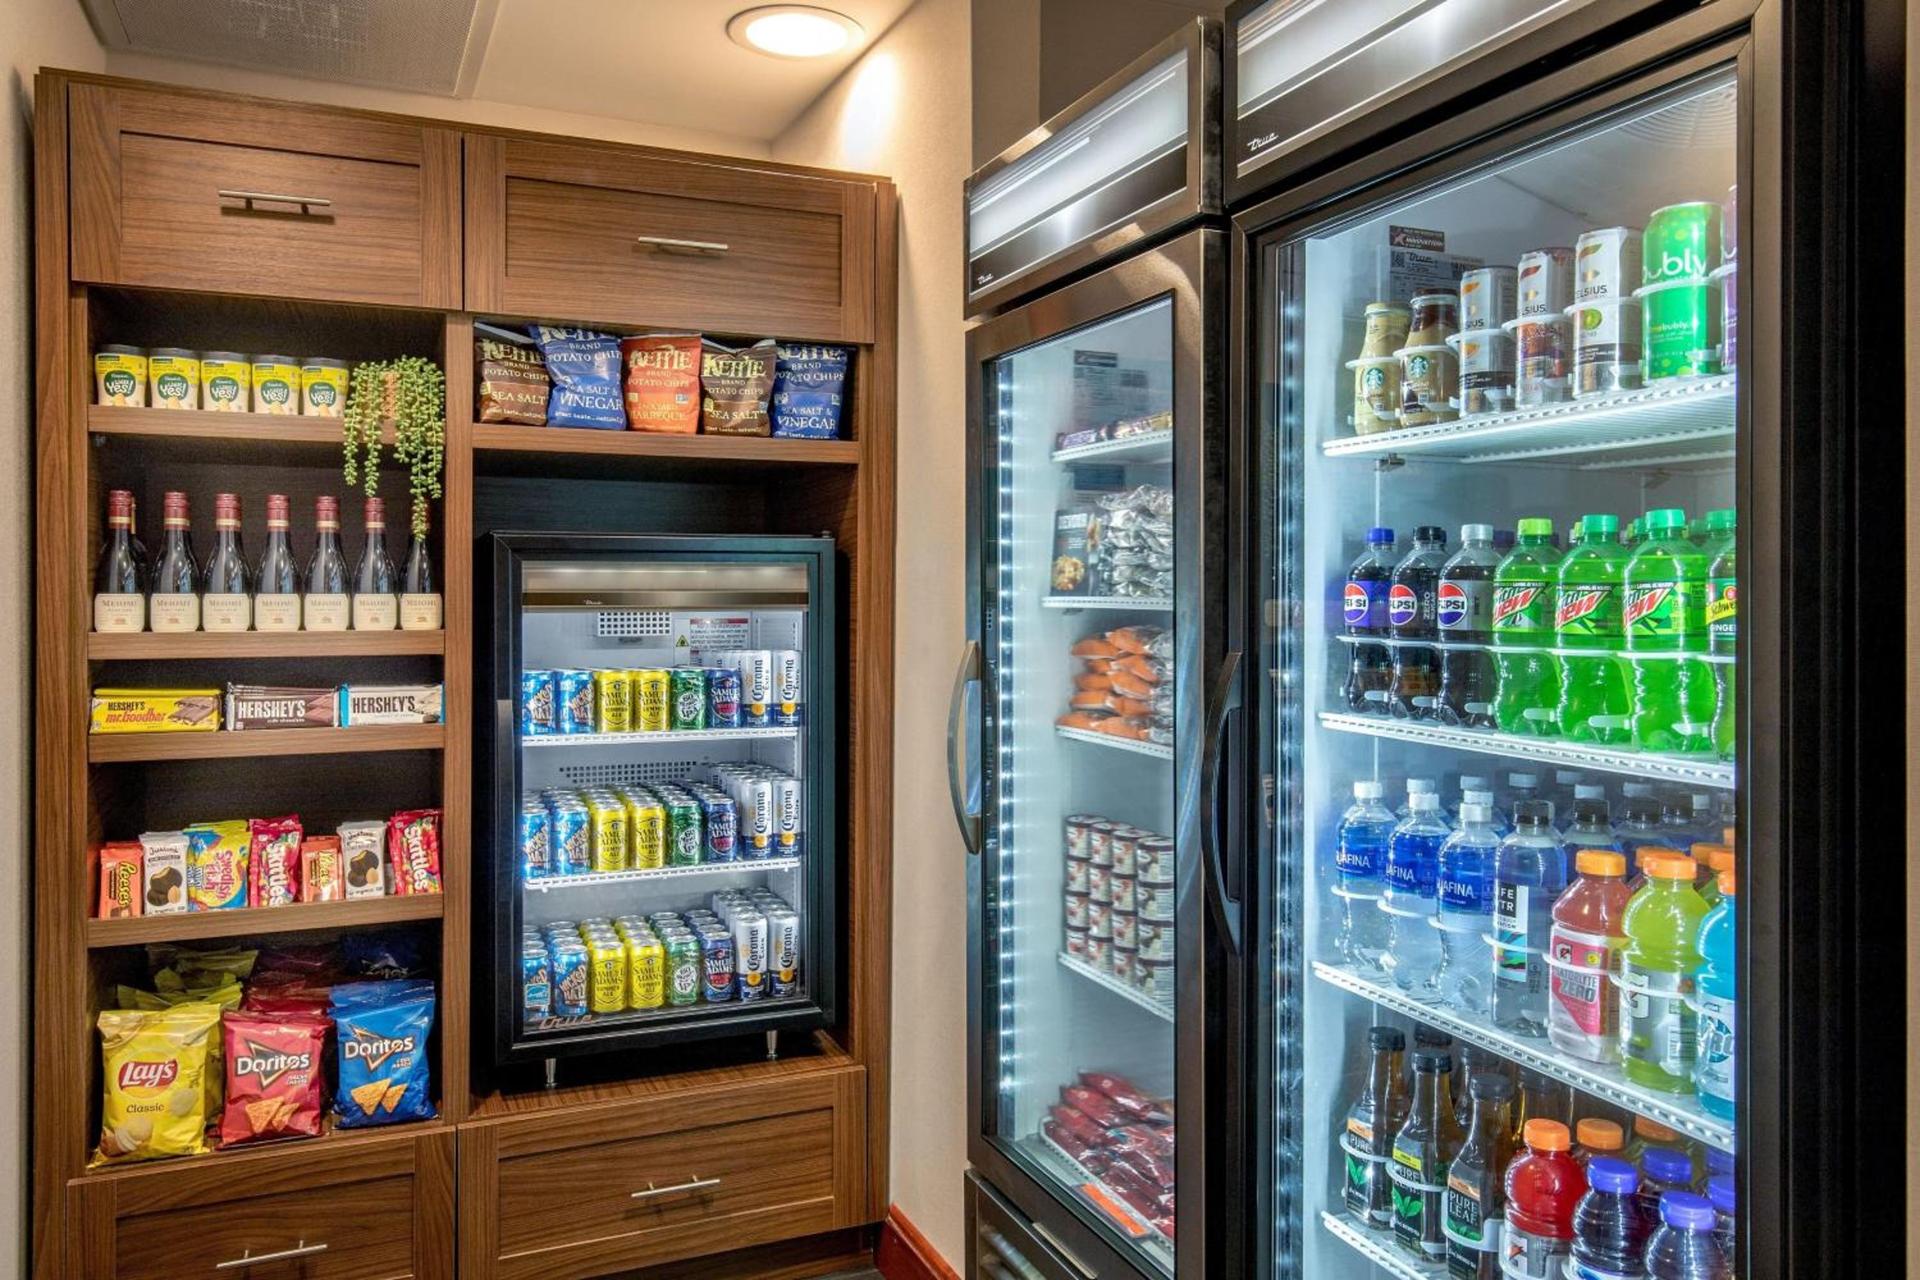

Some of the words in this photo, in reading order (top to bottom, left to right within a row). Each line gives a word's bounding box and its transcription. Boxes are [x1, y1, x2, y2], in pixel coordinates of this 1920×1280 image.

[1247, 133, 1278, 151] True
[1643, 248, 1707, 280] ubly
[701, 353, 767, 378] KETTLE
[813, 371, 845, 381] CHIPS
[106, 380, 133, 395] Yes!
[160, 383, 187, 397] Yes!
[586, 385, 610, 395] SALT
[491, 391, 513, 402] SEA
[518, 392, 546, 405] SALT
[560, 392, 624, 410] VINEGAR
[711, 410, 730, 420] SEA
[731, 410, 759, 420] SALT
[798, 406, 824, 416] SALT
[777, 416, 835, 430] VINEGAR
[1345, 600, 1366, 608] EPSI
[752, 660, 763, 701] Corona
[783, 660, 794, 701] Corona
[238, 700, 306, 719] HERSHEY'S
[353, 696, 416, 714] HERSHEY'S
[755, 791, 766, 833] Corona
[782, 790, 793, 831] Corona
[404, 825, 430, 891] Skittles
[1336, 851, 1371, 868] UAFINA
[205, 864, 220, 890] Fish
[216, 850, 235, 899] Swedish
[266, 842, 288, 907] Skittles
[1386, 863, 1416, 882] AFINA
[1437, 879, 1477, 898] UAFINA
[1500, 888, 1515, 899] FE
[1500, 900, 1515, 912] TR
[748, 929, 760, 971] Corona
[781, 926, 793, 968] Corona
[1561, 978, 1597, 1002] ZERO
[345, 1037, 414, 1058] Doritos
[121, 1060, 175, 1087] Lay's
[237, 1054, 310, 1074] Doritos
[126, 1103, 164, 1114] Classic
[1398, 1166, 1421, 1183] URE
[1449, 1192, 1480, 1212] PURE
[1450, 1202, 1480, 1226] LEAF
